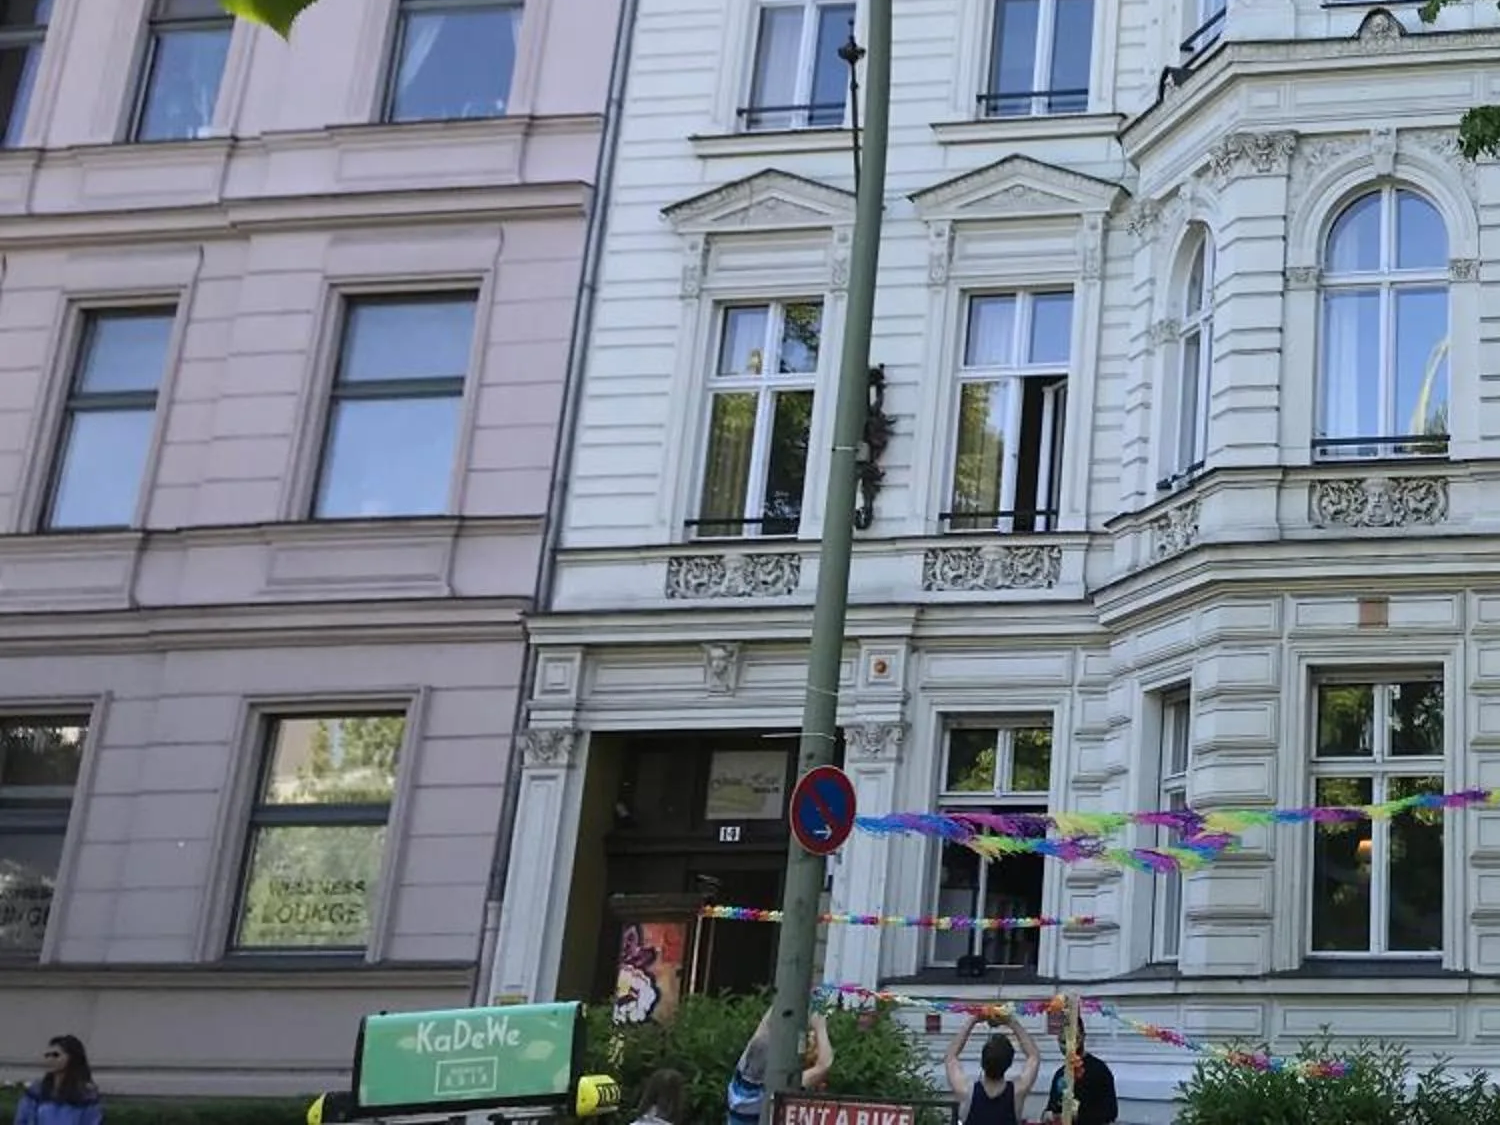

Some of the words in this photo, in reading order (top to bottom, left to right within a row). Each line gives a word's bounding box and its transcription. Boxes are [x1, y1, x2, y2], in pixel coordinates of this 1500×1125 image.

[261, 901, 363, 923] LOUNGE
[416, 1016, 520, 1053] KaDeWe
[784, 1104, 831, 1125] ENT
